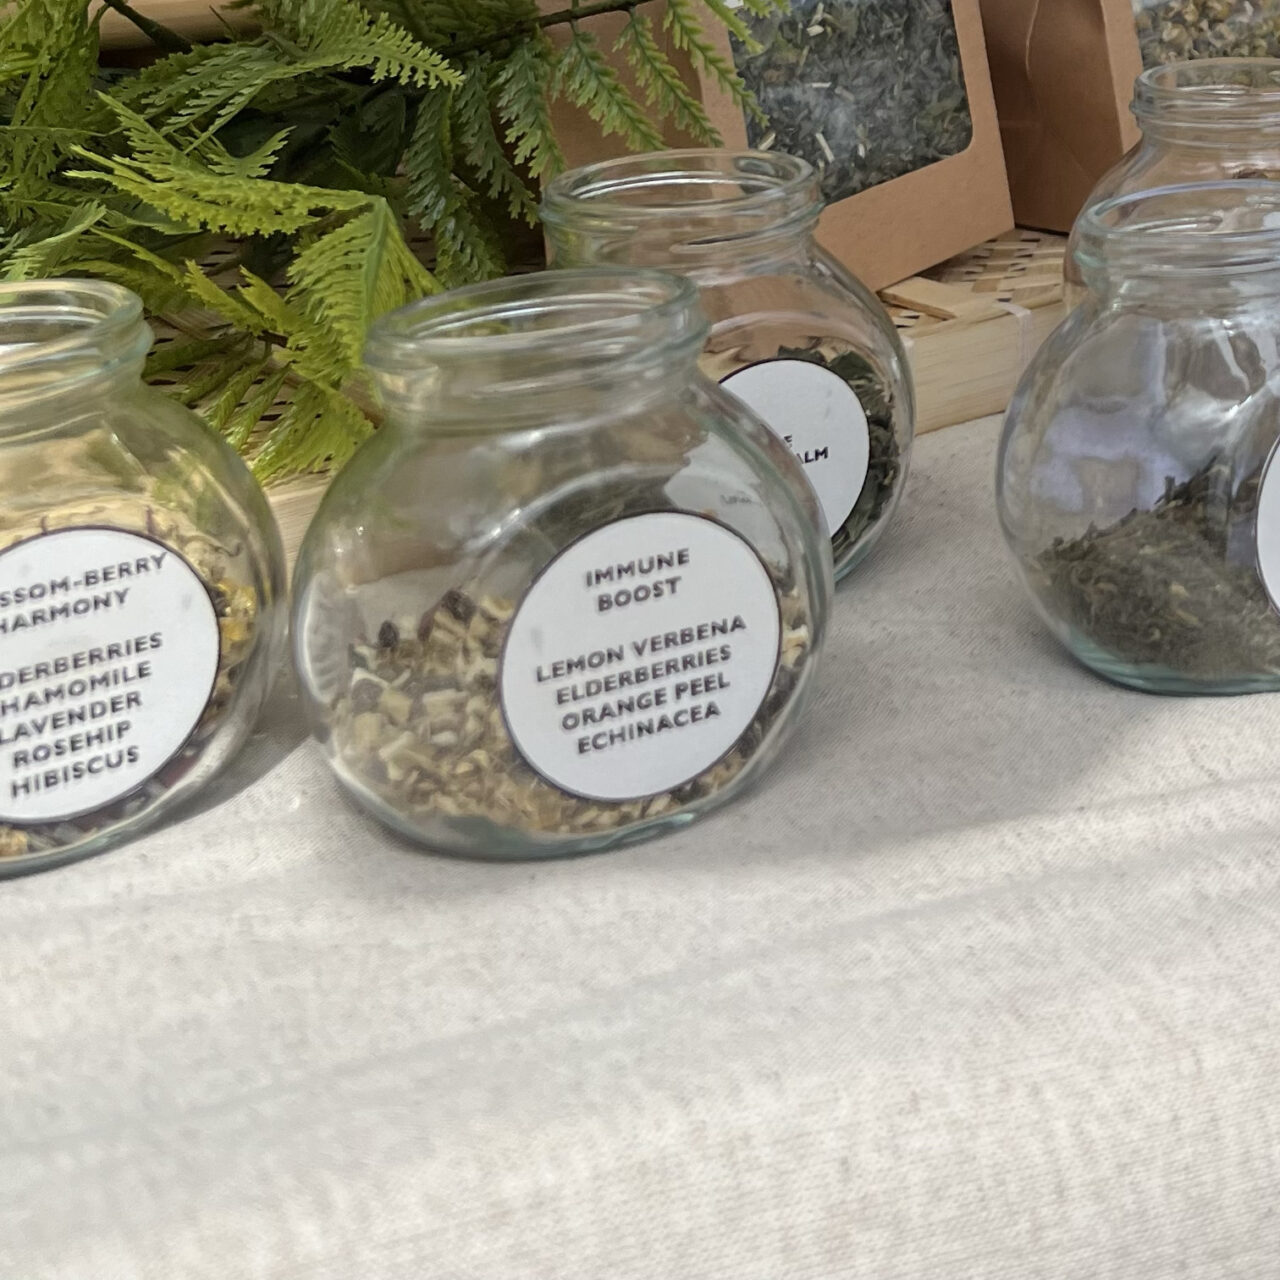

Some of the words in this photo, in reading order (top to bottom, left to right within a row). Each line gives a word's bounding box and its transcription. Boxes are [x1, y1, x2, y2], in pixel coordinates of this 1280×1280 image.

[585, 548, 690, 588] IMMUNE
[597, 575, 683, 612] BOOST
[536, 644, 625, 683] LEMON
[631, 615, 747, 658] VERBENA
[556, 643, 732, 706] ELDERBERRIES
[0, 691, 143, 745] LAVENDER
[561, 687, 669, 731] ORANGE
[674, 672, 731, 701] PEEL
[577, 701, 721, 756] ECHINACEA
[12, 720, 132, 768] ROSEHIP
[10, 746, 140, 799] HIBISCUS
